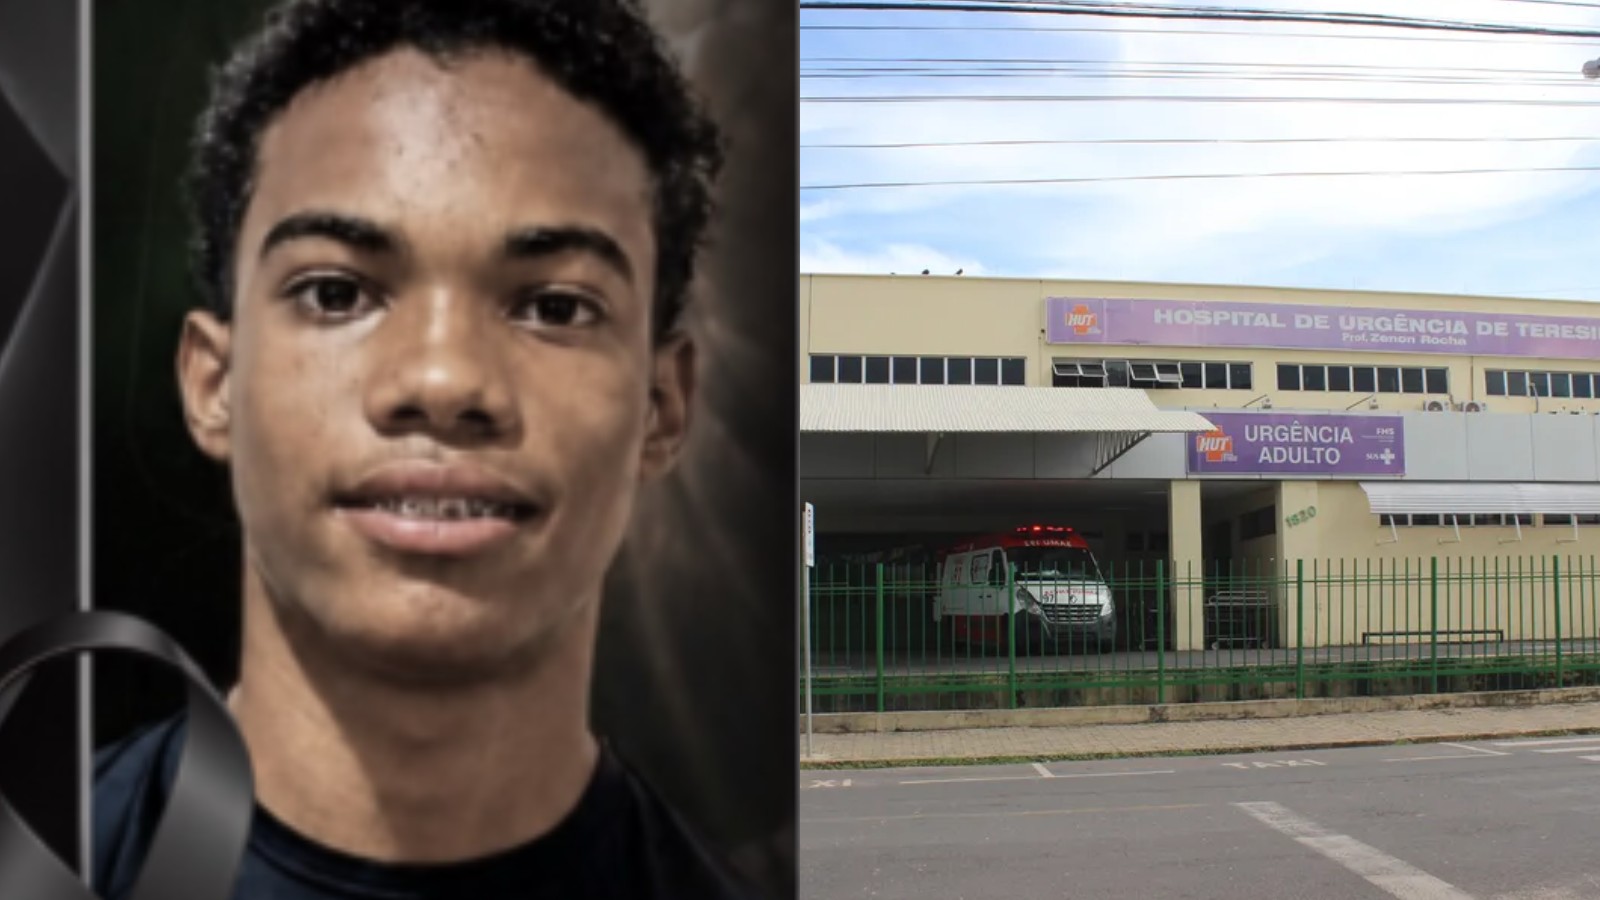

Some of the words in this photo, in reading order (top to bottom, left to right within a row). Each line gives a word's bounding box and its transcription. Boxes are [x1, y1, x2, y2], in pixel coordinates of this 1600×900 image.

[1067, 313, 1094, 327] HUT
[1153, 307, 1286, 329] HOSPITAL
[1294, 314, 1330, 330] DE
[1338, 312, 1469, 335] URGÊNCIA
[1475, 320, 1510, 337] DE
[1514, 322, 1600, 341] TERESI
[1341, 332, 1369, 343] Prof.
[1370, 332, 1416, 345] Zenon
[1420, 335, 1468, 347] Rocha
[1244, 420, 1354, 444] URGÊNCIA
[1199, 436, 1230, 452] HUT
[1258, 446, 1341, 465] ADULTO
